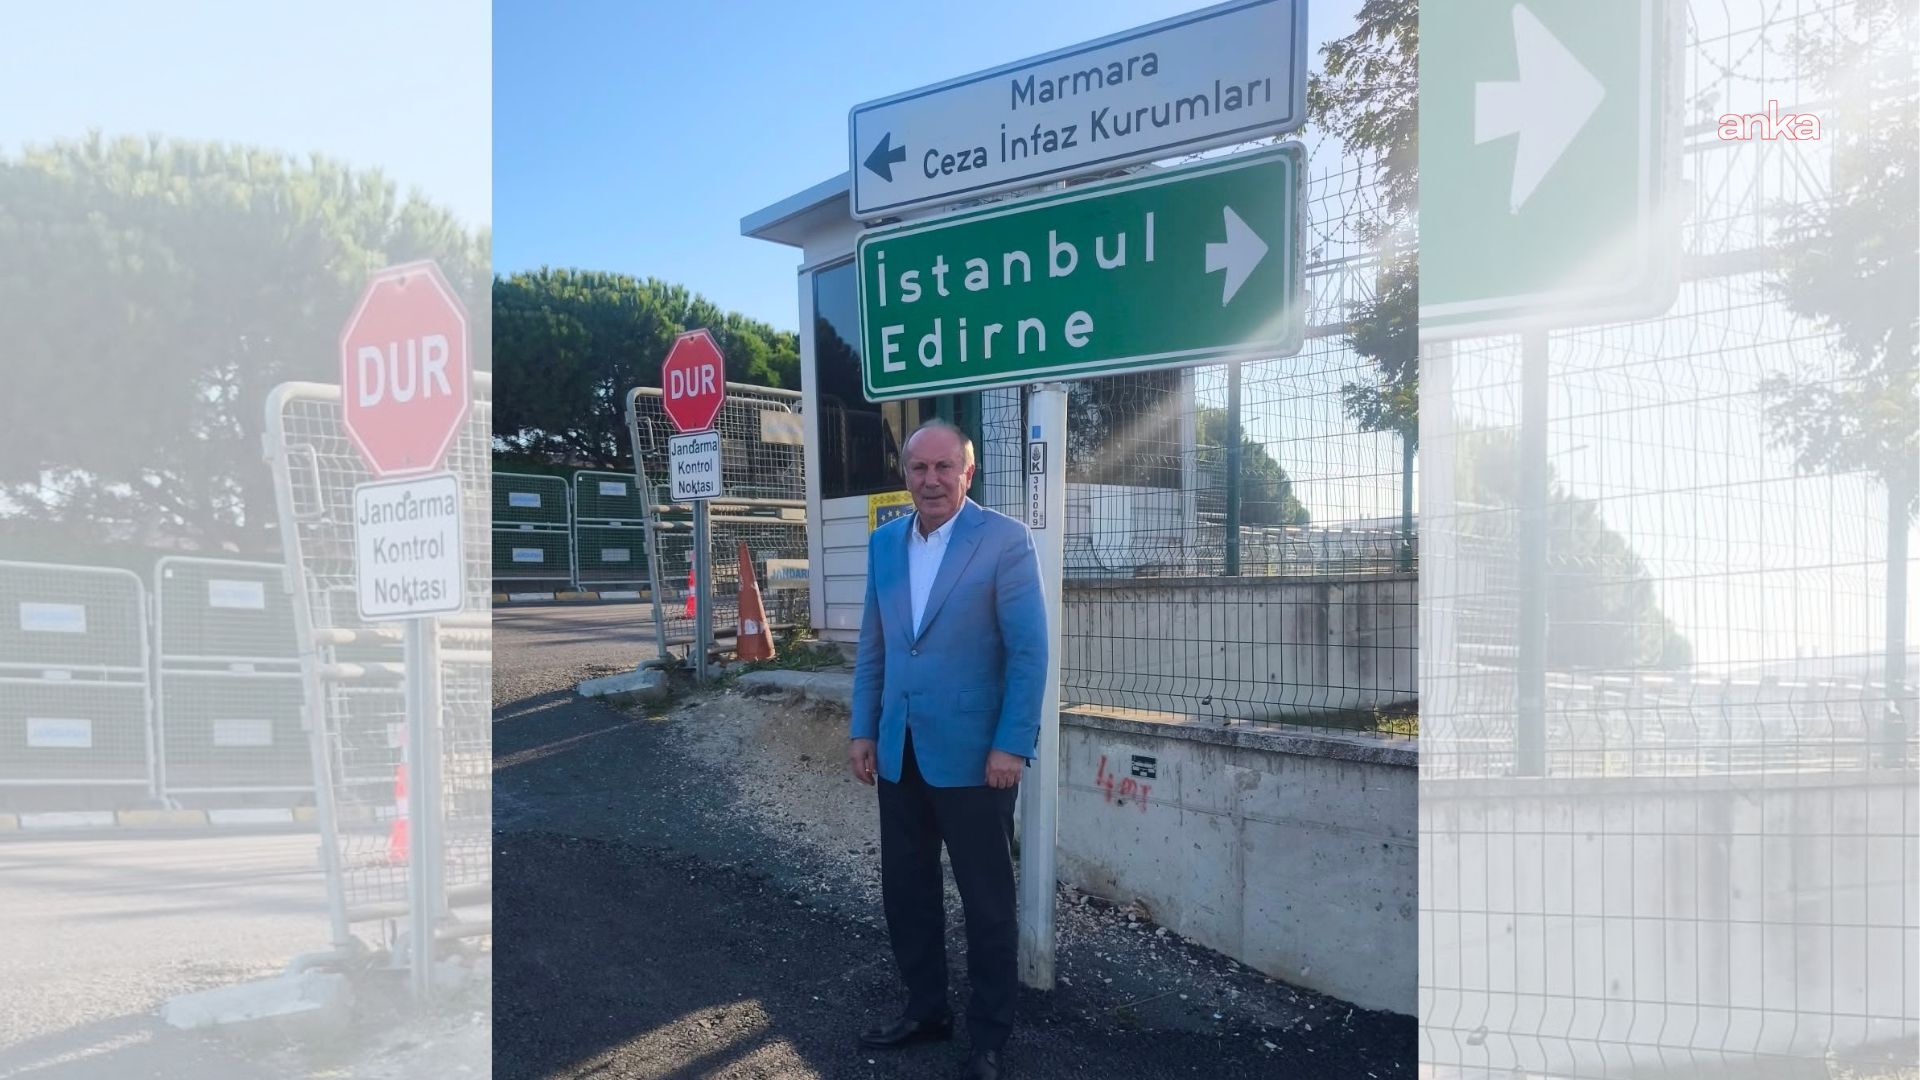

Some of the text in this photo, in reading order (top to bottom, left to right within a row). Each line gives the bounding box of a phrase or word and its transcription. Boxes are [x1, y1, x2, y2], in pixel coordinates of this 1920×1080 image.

[1011, 52, 1159, 111] Marmara
[923, 77, 1271, 180] Ceza İnfaz Kurumları
[877, 212, 1156, 307] İstanbul
[880, 310, 1095, 374] Edirne
[357, 333, 452, 408] DUR
[670, 363, 716, 400] DUR
[671, 439, 718, 456] Jandarma
[677, 458, 713, 476] Kontrol
[677, 479, 714, 495] Noktası
[359, 492, 455, 526] Jandarma
[373, 531, 445, 565] Kontrol
[772, 567, 810, 579] JANDAR
[374, 577, 447, 605] Noktası
